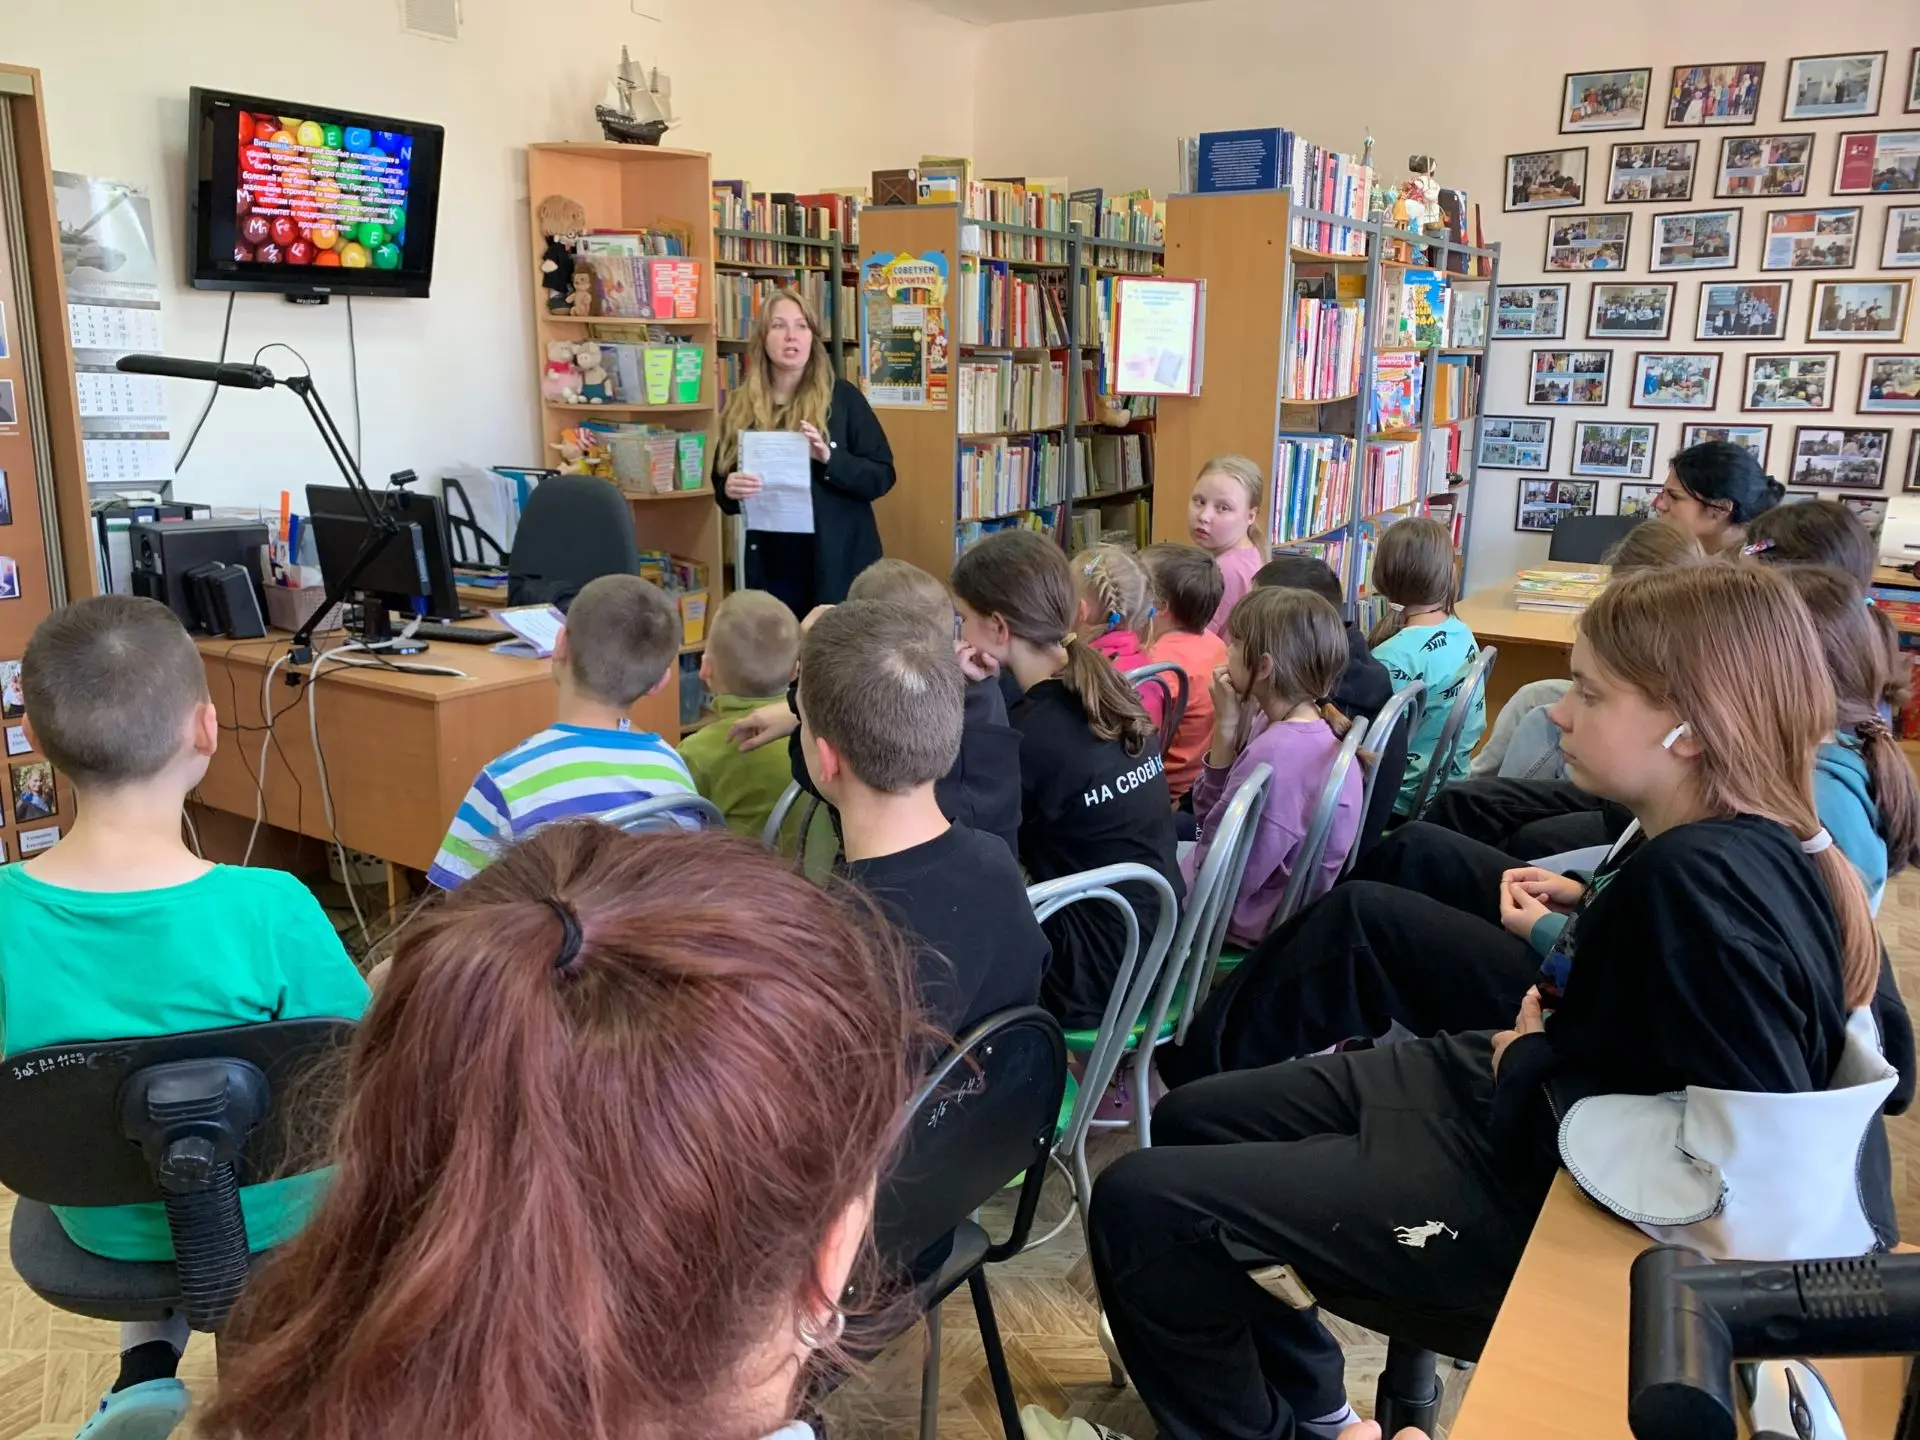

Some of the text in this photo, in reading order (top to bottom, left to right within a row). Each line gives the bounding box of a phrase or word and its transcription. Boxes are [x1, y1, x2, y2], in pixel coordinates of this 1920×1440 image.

[276, 218, 290, 235] Fe
[893, 266, 935, 276] СОВЕТУЕМ
[892, 276, 937, 286] ПОЧИТАТЬ
[1426, 637, 1448, 652] NIKE
[1083, 784, 1114, 808] НА
[1116, 756, 1158, 794] СВОЕЙ
